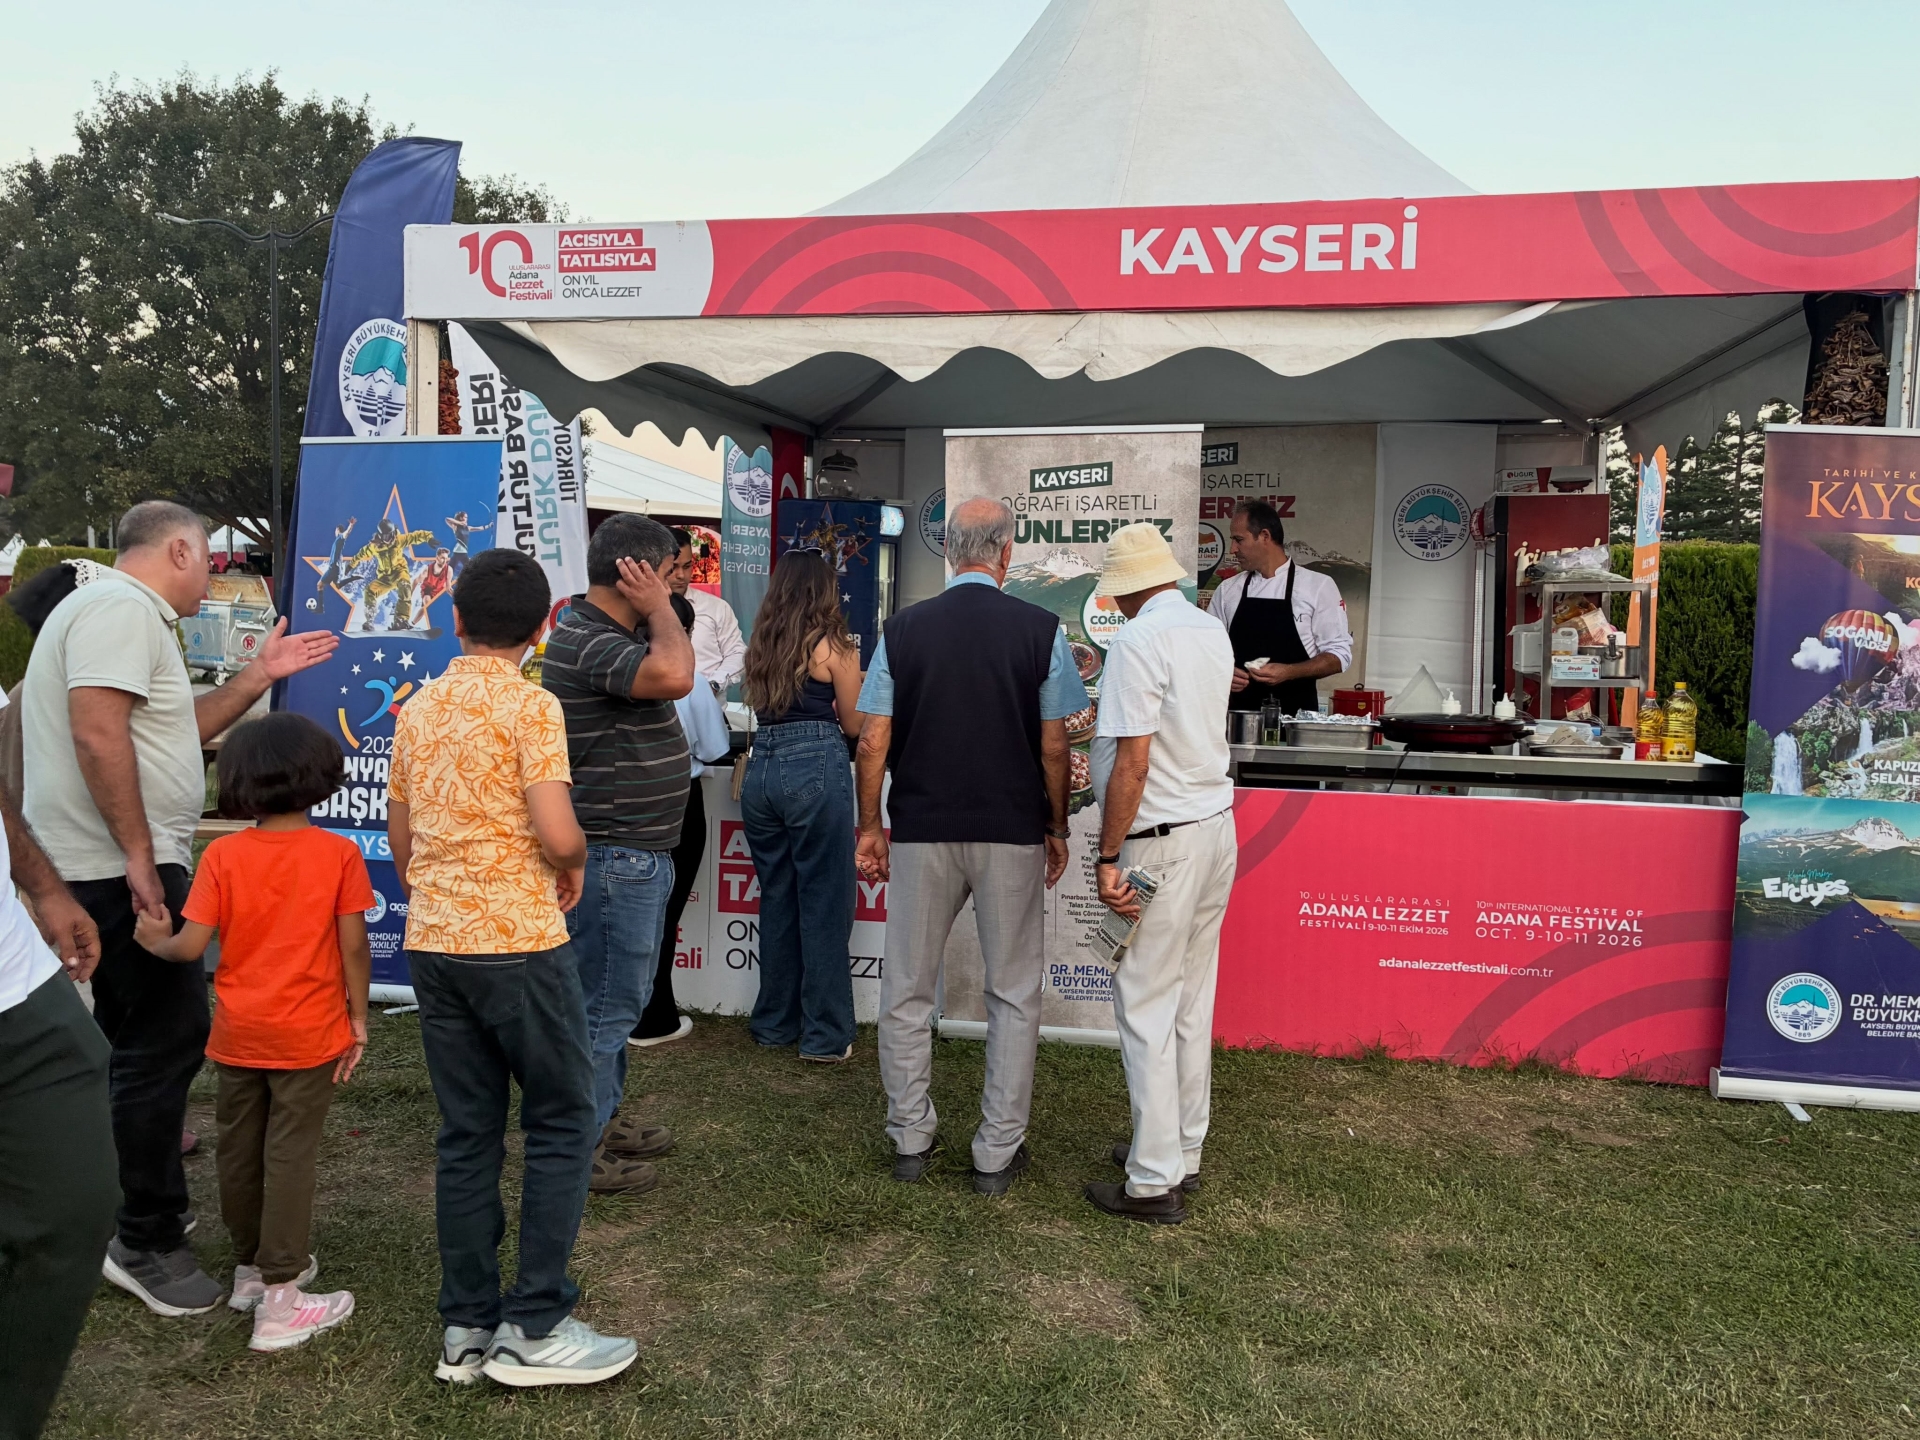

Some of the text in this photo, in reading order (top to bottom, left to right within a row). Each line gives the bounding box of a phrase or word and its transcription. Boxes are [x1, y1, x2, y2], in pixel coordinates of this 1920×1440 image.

[560, 234, 635, 248] ACISIYLA
[1120, 205, 1418, 274] KAYSERİ
[560, 252, 652, 268] TATLISIYLA
[508, 271, 538, 280] Adana
[562, 275, 599, 286] ON YIL
[510, 280, 544, 290] Lezzet
[600, 286, 642, 298] LEZZET
[510, 289, 552, 300] Festivali
[356, 322, 407, 346] BÜYÜKŞEH
[1824, 467, 1874, 478] TARİHİ
[1884, 470, 1900, 479] VE
[1806, 480, 1920, 522] KAYS
[1090, 612, 1128, 625] COĞR
[362, 736, 394, 754] 202
[344, 756, 388, 783] NYA
[1874, 760, 1920, 772] KAPUZ
[1870, 772, 1920, 786] ŞELALE
[1762, 877, 1850, 906] Erciyes
[1085, 902, 1108, 910] Zincider
[1300, 891, 1450, 907] 10. ULUSLARARASI
[1298, 902, 1450, 923] ADANA LEZZET
[1476, 900, 1494, 909] 10th
[1496, 902, 1574, 914] INTERNATIONAL
[1575, 906, 1618, 916] TASTE
[1300, 919, 1449, 936] FESTİVALİ 9-10-11 EKİM 2026
[1476, 912, 1644, 932] ADANA FESTIVAL
[368, 932, 400, 942] EMDUH
[1475, 927, 1642, 947] OCT. 9-10-11 2026
[370, 942, 399, 951] KKILIÇ
[1050, 964, 1071, 975] DR.
[1378, 956, 1554, 978] adanalezzetfestivali.com.tr
[1053, 976, 1112, 988] BÜYÜKKI
[1850, 994, 1920, 1008] DR. MEM
[1853, 1008, 1920, 1022] BÜYÜKK
